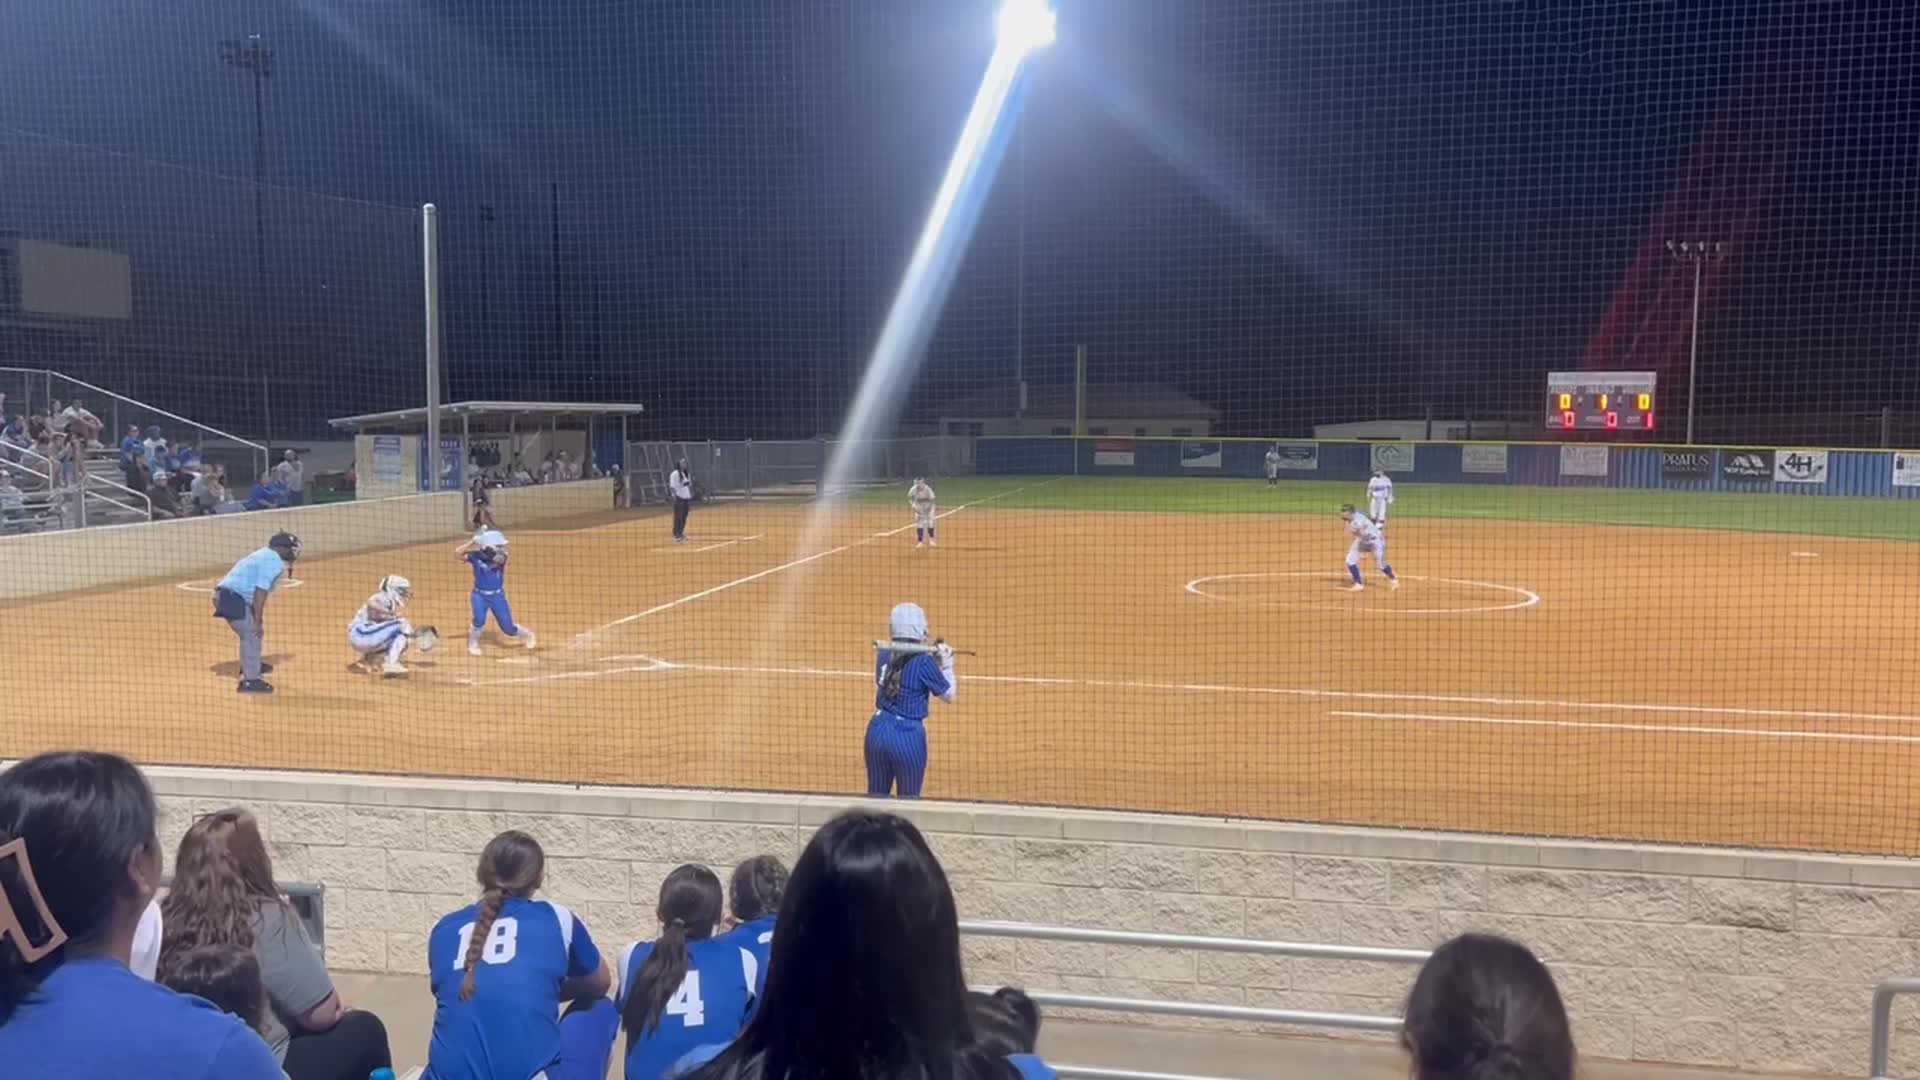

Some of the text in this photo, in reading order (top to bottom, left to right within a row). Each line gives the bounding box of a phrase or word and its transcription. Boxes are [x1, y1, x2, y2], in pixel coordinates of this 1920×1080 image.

[1560, 393, 1650, 410] 0 1 0
[1564, 411, 1575, 427] 0
[1607, 411, 1617, 427] 0
[453, 916, 518, 970] 18
[666, 969, 705, 1027] 4
